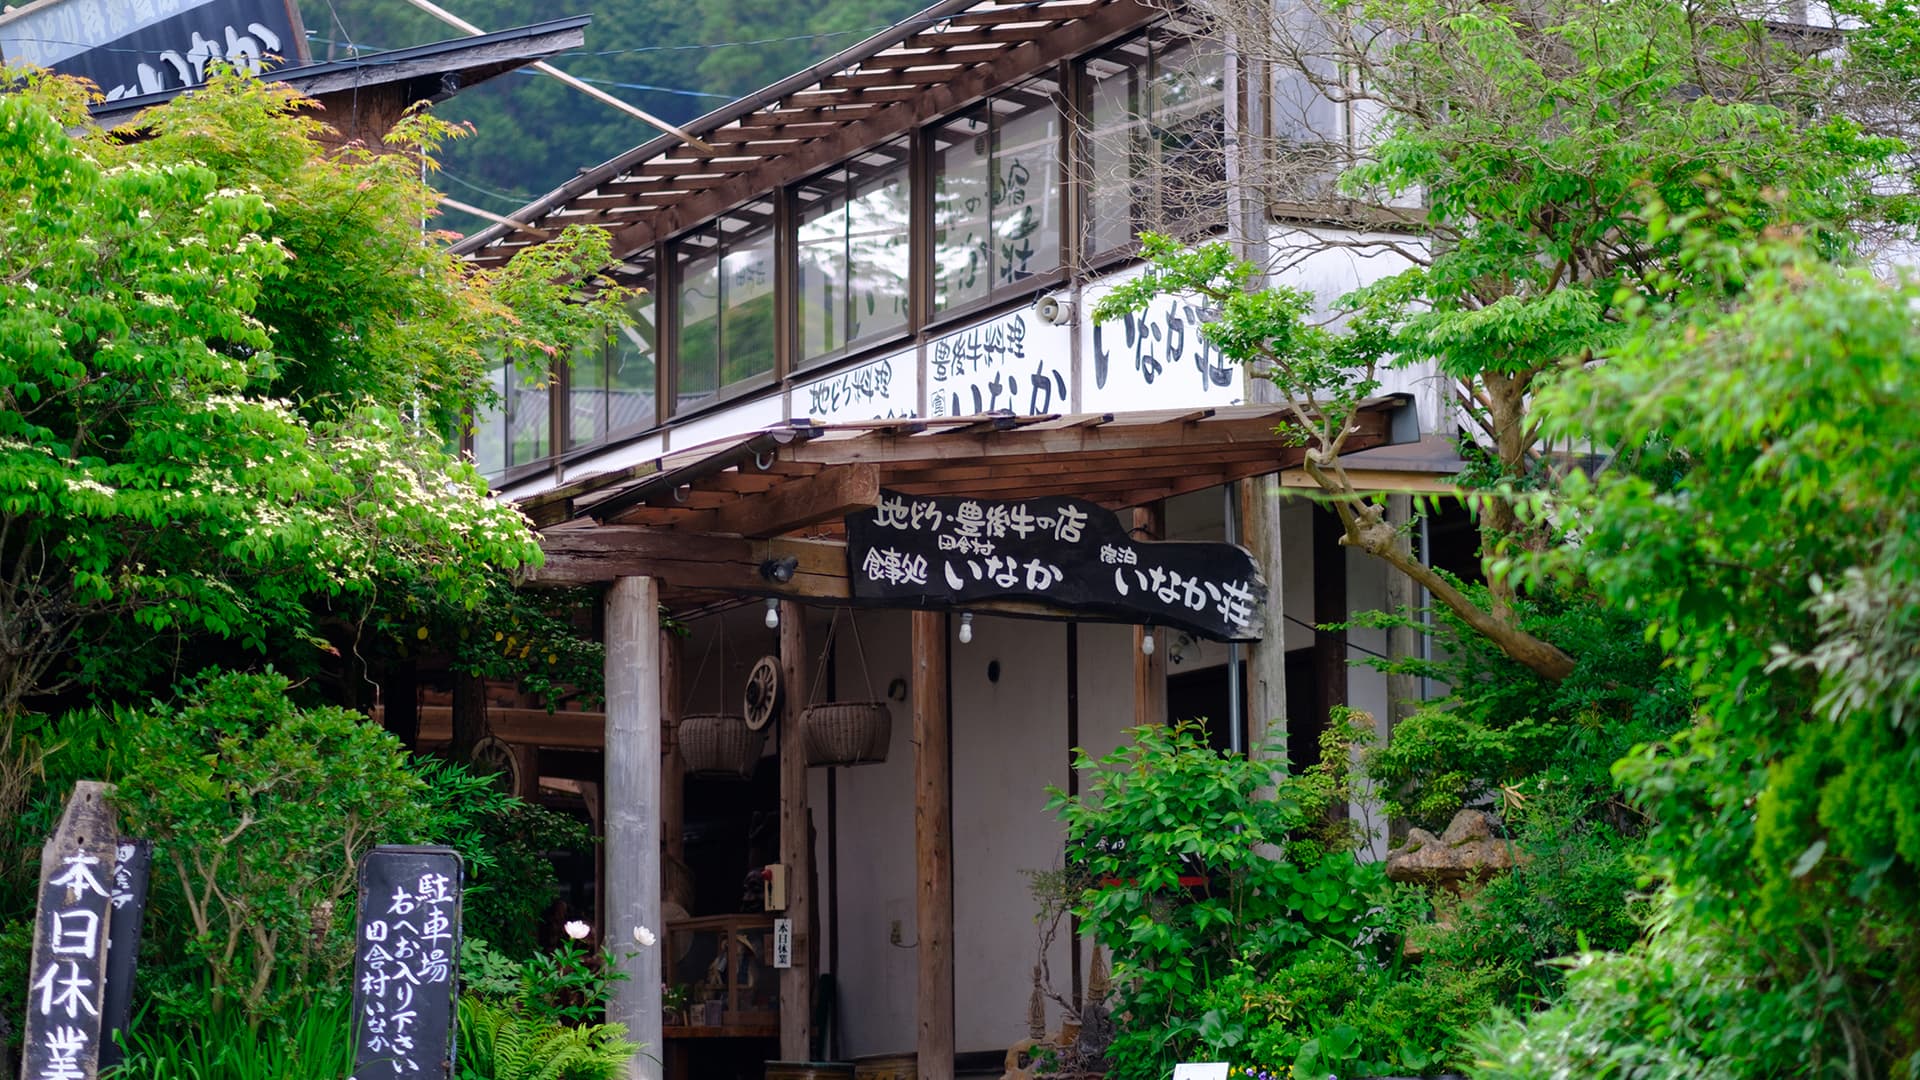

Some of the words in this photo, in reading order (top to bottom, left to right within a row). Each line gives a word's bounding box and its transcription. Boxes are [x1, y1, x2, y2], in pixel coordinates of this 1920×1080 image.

[862, 546, 928, 585] 食事処
[938, 534, 995, 556] 田舎村
[1101, 543, 1137, 565] 宿泊
[944, 555, 1064, 590] いなか
[1114, 565, 1253, 627] いなか荘
[415, 873, 453, 984] 駐車場
[33, 848, 111, 1080] 本日休業
[386, 885, 421, 1073] 右へお入り下さい
